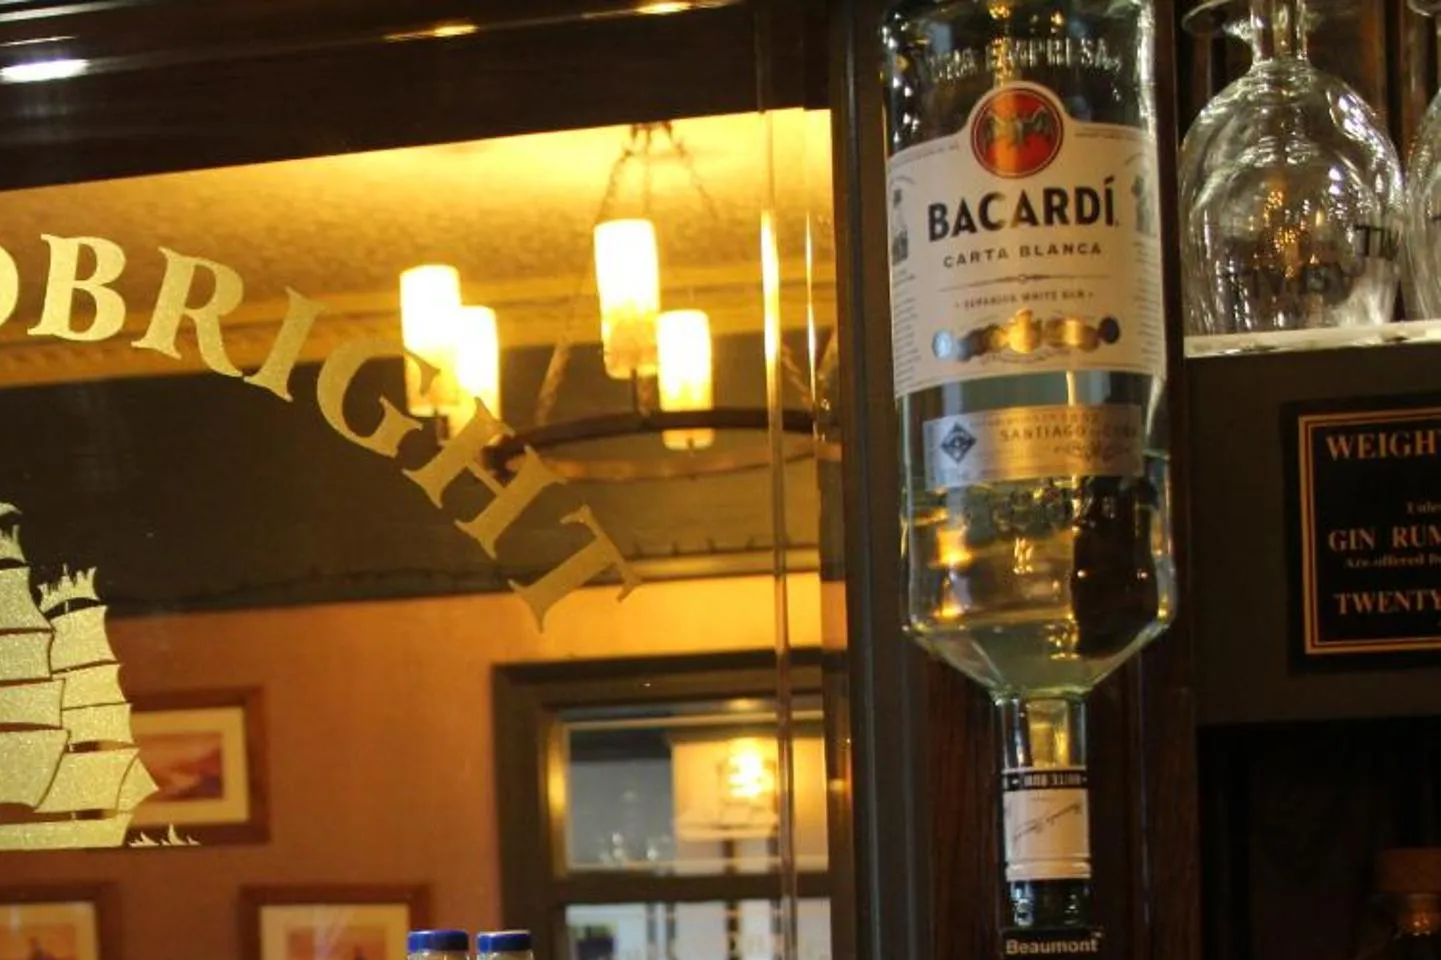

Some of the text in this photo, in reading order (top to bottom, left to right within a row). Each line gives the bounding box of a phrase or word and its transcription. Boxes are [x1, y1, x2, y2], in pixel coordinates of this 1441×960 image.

[928, 175, 1116, 243] BACARDÍ
[943, 242, 1103, 269] CARTA BLANCA
[1325, 428, 1441, 461] WEIGH
[1327, 527, 1378, 552] GIN
[1005, 936, 1098, 956] Beaumont
